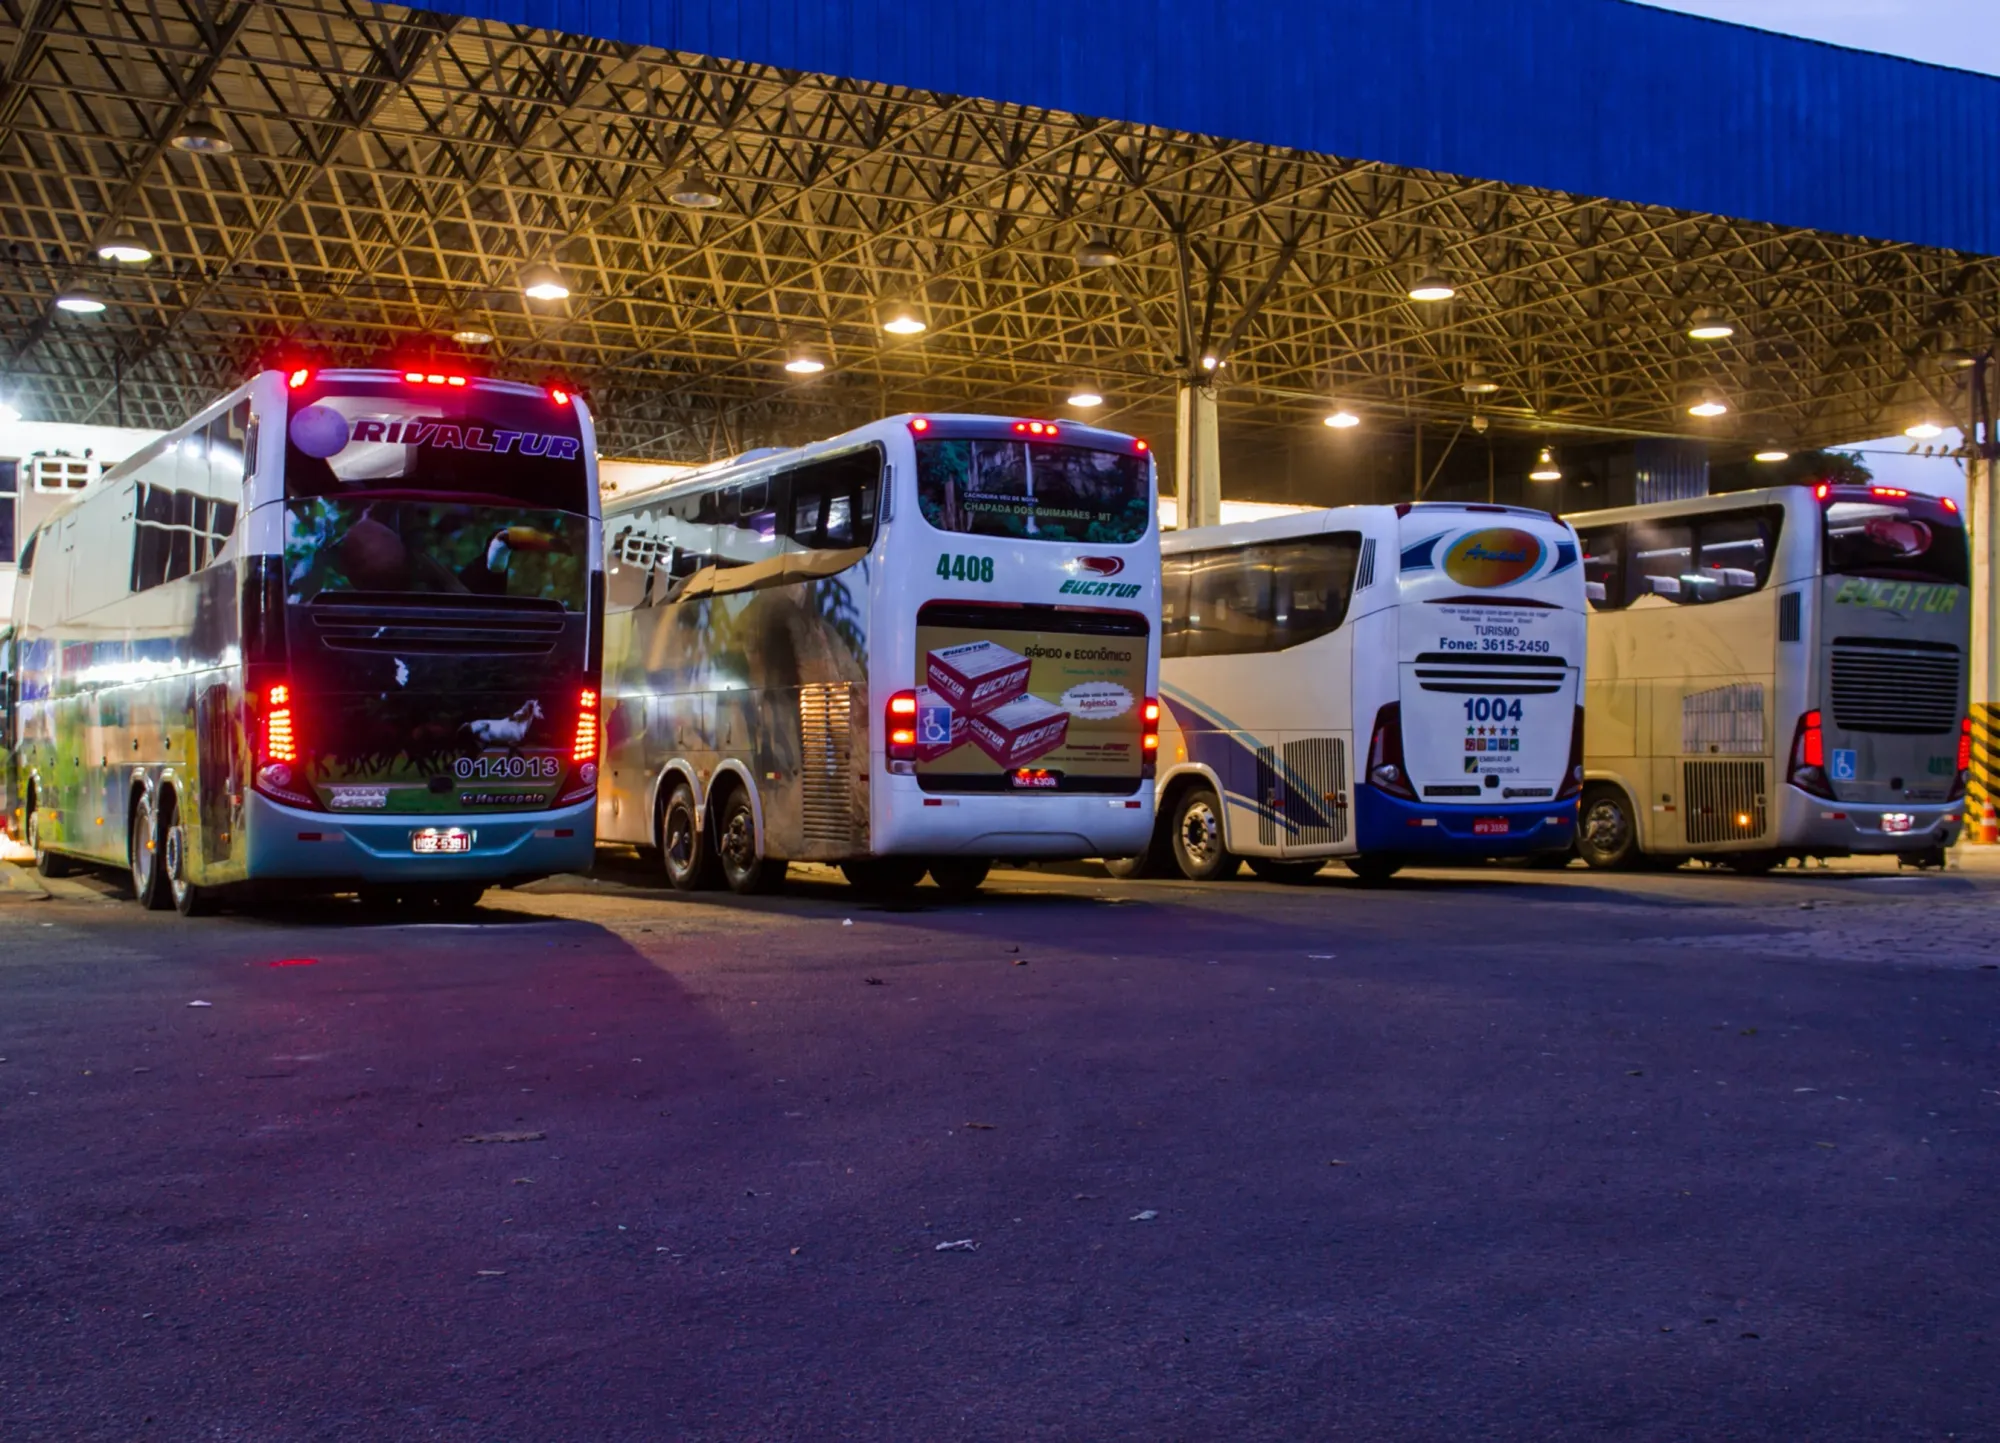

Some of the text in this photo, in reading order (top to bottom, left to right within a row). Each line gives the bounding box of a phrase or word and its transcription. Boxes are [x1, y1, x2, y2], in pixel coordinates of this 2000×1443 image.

[351, 421, 580, 460] RIVALTUR
[964, 502, 1011, 513] CHAPADA
[1013, 505, 1034, 515] DOS
[1036, 506, 1090, 520] GUIMARÃES
[1098, 512, 1112, 521] MT
[936, 553, 994, 583] 4408
[1059, 580, 1142, 599] EUCATUR
[1836, 579, 1959, 613] EUCATUR
[1474, 625, 1520, 637] TURISMO
[1024, 644, 1062, 659] RÁPIDO
[1065, 650, 1071, 659] e
[1440, 637, 1550, 653] Fone: 3615-2450
[929, 664, 965, 696] EUCATUR
[1080, 698, 1117, 709] Agências
[1464, 698, 1523, 722] 1004
[454, 757, 559, 778] 014013
[475, 793, 545, 803] Marcopolo
